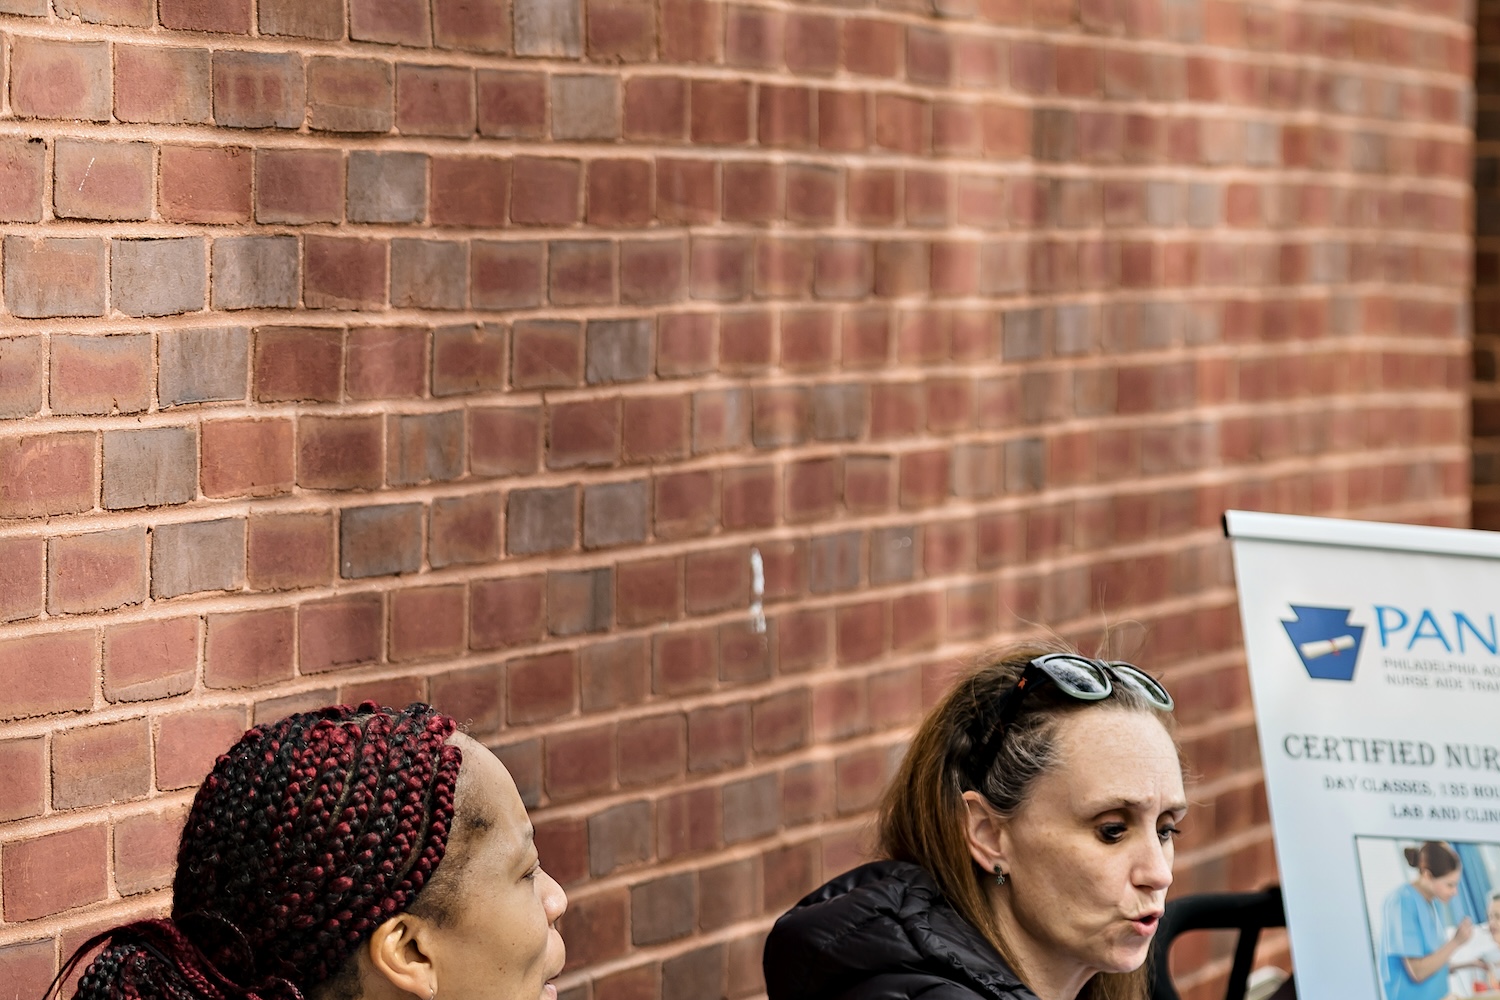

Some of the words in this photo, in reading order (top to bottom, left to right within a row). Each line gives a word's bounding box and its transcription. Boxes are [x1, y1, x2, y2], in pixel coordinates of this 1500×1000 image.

[1384, 658, 1479, 674] PHILADELPHIA
[1386, 674, 1430, 687] NURSE
[1436, 677, 1463, 689] AIDE
[1282, 732, 1436, 767] CERTIFIED
[1323, 775, 1357, 791] DAY
[1392, 804, 1424, 820] LAB
[1430, 807, 1460, 822] AND
